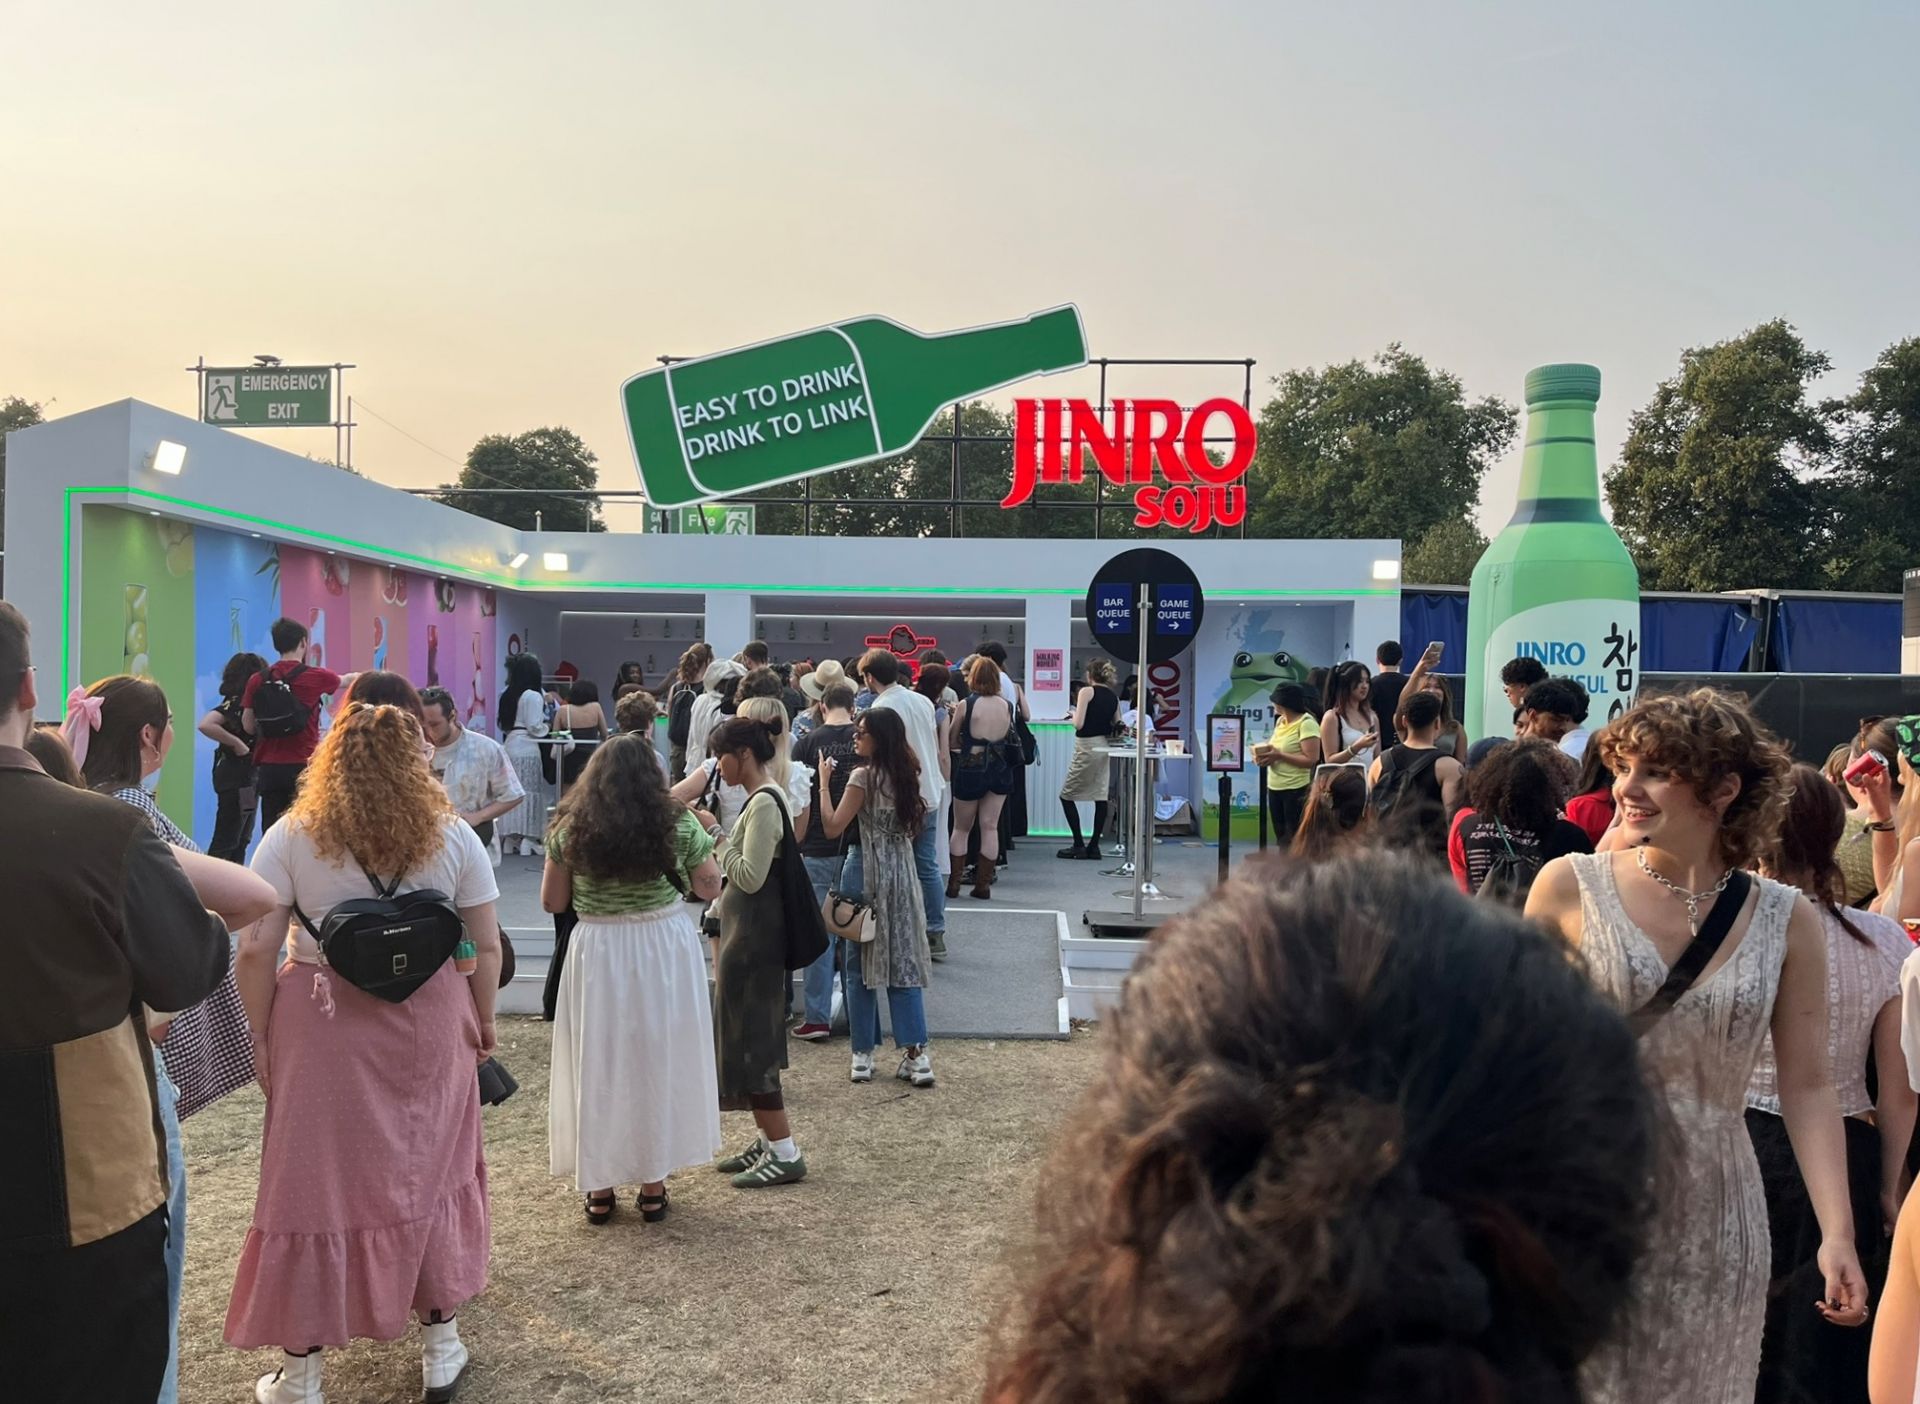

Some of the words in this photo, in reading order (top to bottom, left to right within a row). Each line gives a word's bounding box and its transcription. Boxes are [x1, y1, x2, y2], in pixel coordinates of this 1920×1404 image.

[241, 374, 328, 392] EMERGENCY
[678, 393, 737, 428] EASY
[743, 384, 777, 411] TO
[781, 363, 861, 402] DRINK
[267, 402, 301, 419] EXIT
[686, 421, 765, 460] DRINK
[767, 412, 803, 438] TO
[808, 395, 868, 430] LINK
[1000, 397, 1257, 509] JINRO
[1134, 485, 1247, 534] SOJU
[1103, 598, 1124, 607] BAR
[1160, 599, 1189, 608] GAME
[1096, 609, 1131, 619] QUEUE
[1157, 611, 1192, 620] QUEUE
[1147, 659, 1181, 741] INRO
